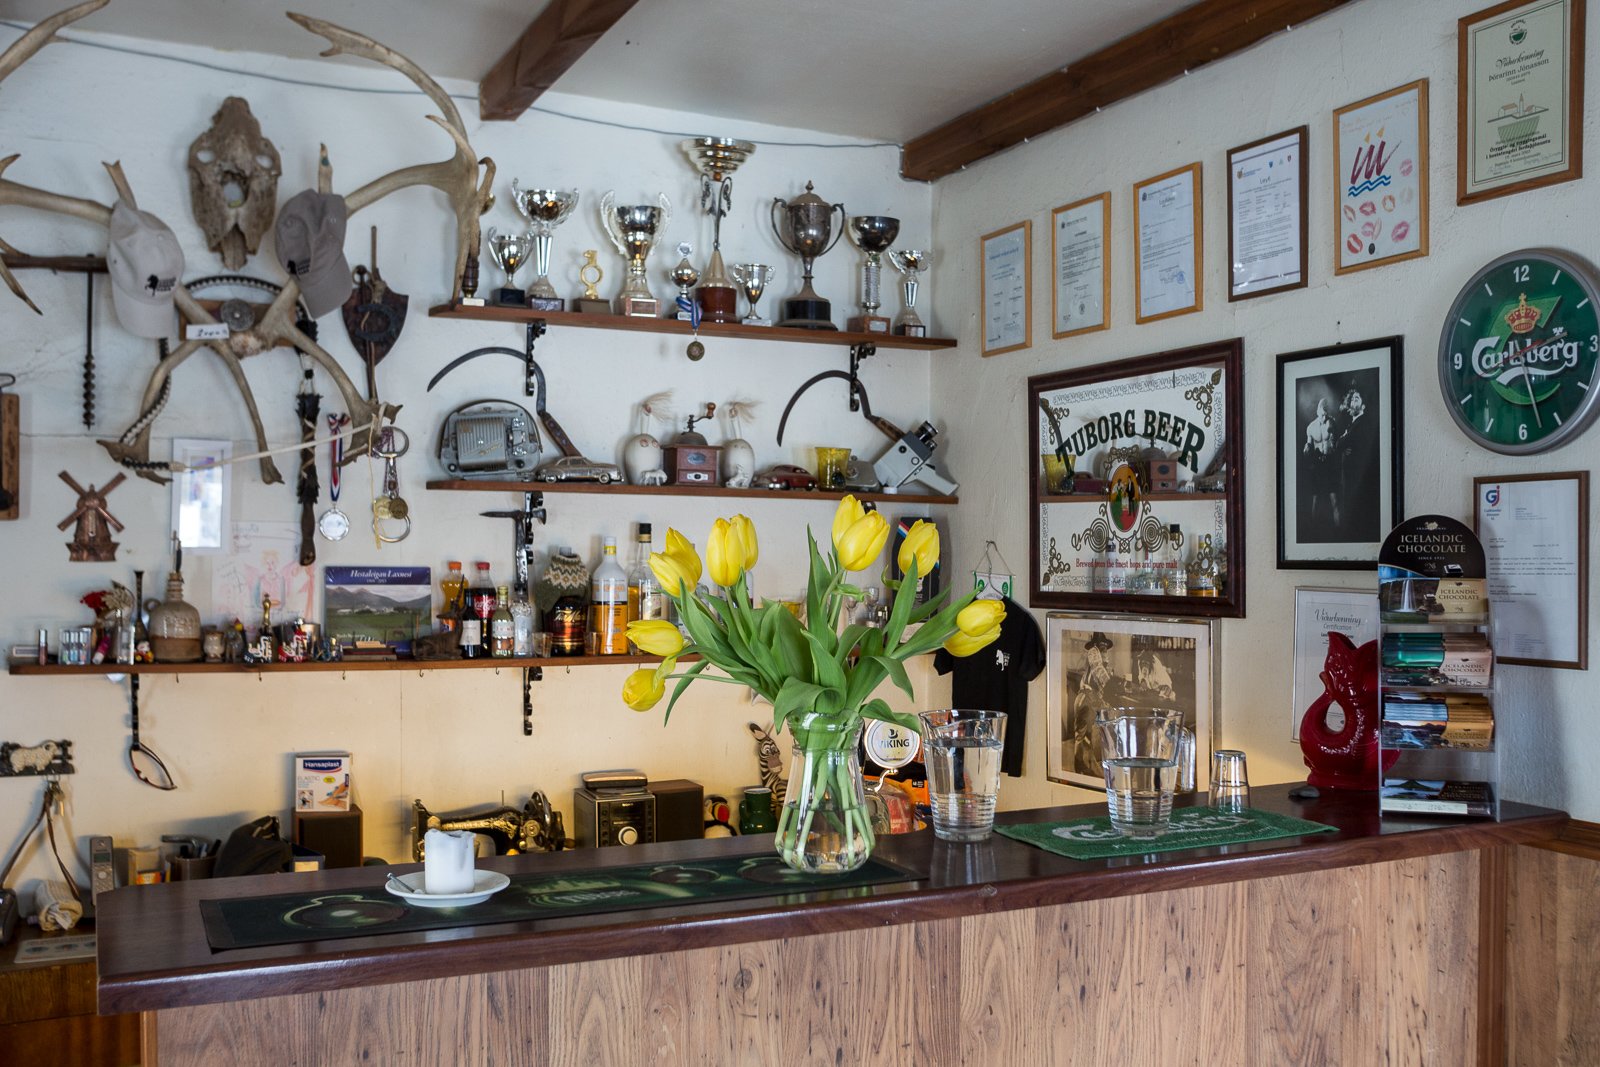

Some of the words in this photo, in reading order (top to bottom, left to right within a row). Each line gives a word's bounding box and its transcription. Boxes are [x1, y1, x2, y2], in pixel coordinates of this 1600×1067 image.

[1513, 265, 1530, 283] 12
[1454, 353, 1463, 370] 9
[1590, 335, 1599, 352] 3
[1518, 424, 1528, 440] 6
[1055, 409, 1136, 479] TUBORG
[1143, 409, 1206, 474] BEER
[1401, 534, 1463, 543] ICELANDIC
[1397, 544, 1466, 553] CHOCOLATE
[1106, 558, 1114, 568] the
[1130, 559, 1141, 571] hops
[1142, 558, 1152, 569] and
[1152, 561, 1164, 570] pure
[1165, 558, 1178, 569] malt
[878, 739, 910, 748] VIKING
